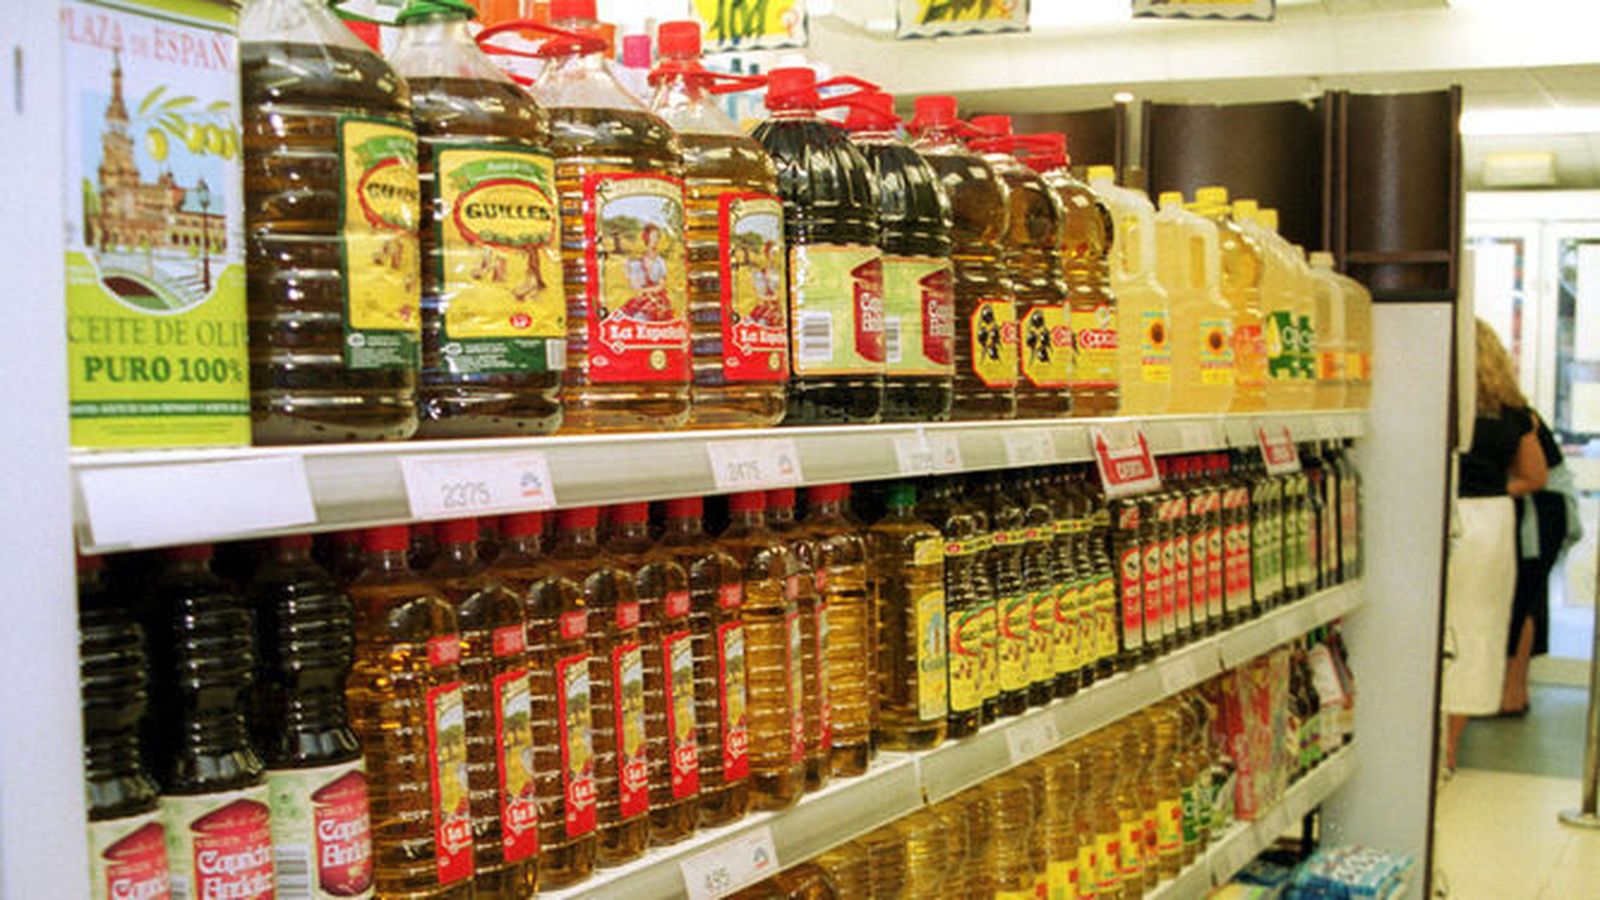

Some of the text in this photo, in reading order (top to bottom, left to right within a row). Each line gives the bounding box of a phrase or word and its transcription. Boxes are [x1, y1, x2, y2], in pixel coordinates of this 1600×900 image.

[466, 203, 551, 221] GUILLES
[155, 318, 191, 346] DE
[609, 325, 631, 340] La
[84, 355, 243, 384] PURO 100%
[440, 481, 492, 509] 2375
